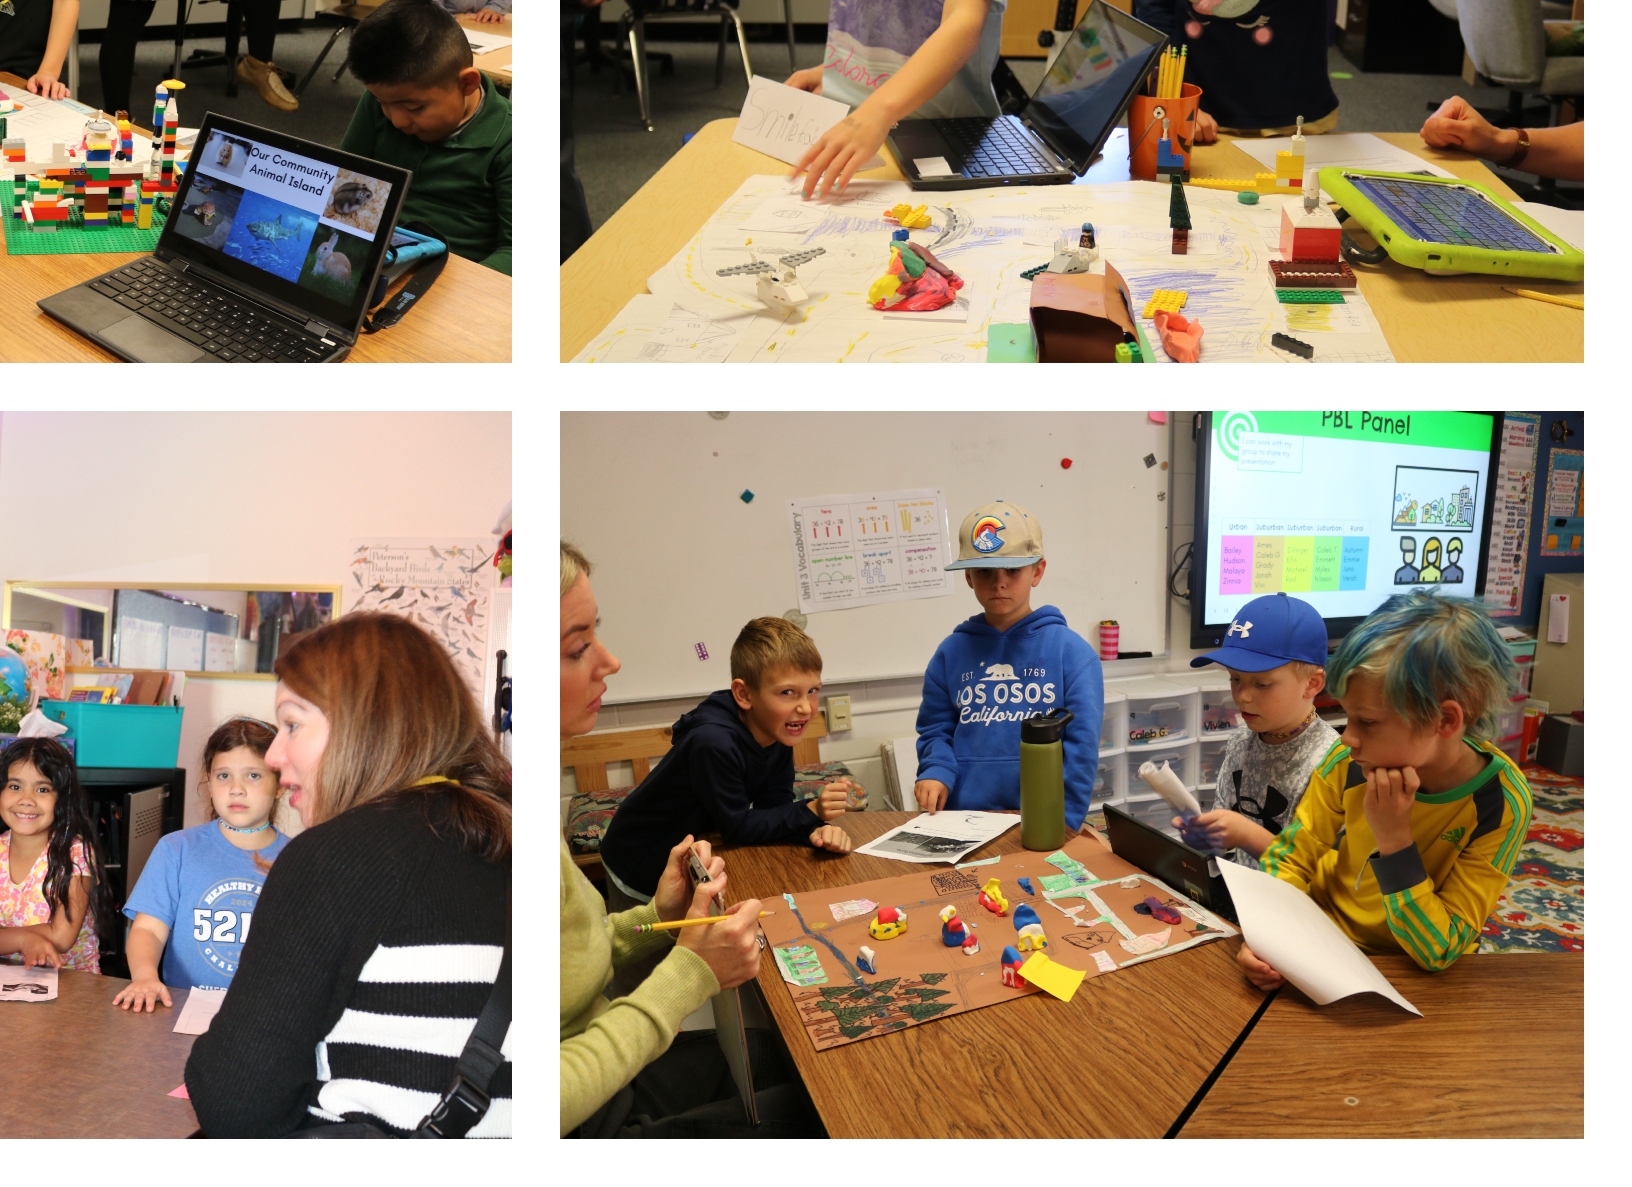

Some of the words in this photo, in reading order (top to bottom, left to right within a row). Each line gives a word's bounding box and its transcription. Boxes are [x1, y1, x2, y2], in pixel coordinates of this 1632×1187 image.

[251, 147, 271, 161] Our
[272, 154, 335, 185] Community
[249, 164, 288, 184] Animal
[288, 176, 325, 196] Island
[1322, 411, 1353, 429] PBL
[1361, 411, 1411, 436] Panel
[1257, 438, 1271, 446] work
[1272, 439, 1284, 447] with
[1509, 434, 1525, 442] Morning
[1241, 449, 1259, 457] group
[1266, 449, 1282, 457] share
[1241, 458, 1276, 466] presentation
[1316, 524, 1343, 532] Suburban
[793, 512, 807, 573] Vocabulary
[877, 550, 891, 558] apart
[905, 546, 937, 554] compensation
[1224, 547, 1242, 555] Bailey
[373, 551, 409, 561] Peterson's
[372, 562, 407, 573] Backyard
[410, 562, 430, 572] Birds
[1256, 562, 1274, 570] Grady
[380, 574, 406, 585] Rocky
[408, 575, 445, 585] Mountain
[447, 577, 470, 586] States
[802, 582, 811, 600] Unit
[961, 671, 976, 682] EST.
[1023, 668, 1046, 677] 1769
[956, 683, 987, 708] LOS
[993, 682, 1056, 704] OSOS
[1204, 720, 1230, 731] Vivien
[1129, 729, 1157, 741] Caleb
[1159, 727, 1168, 737] G.
[204, 881, 255, 905] HEALTHY
[230, 898, 253, 907] 2024
[193, 908, 252, 944] 521
